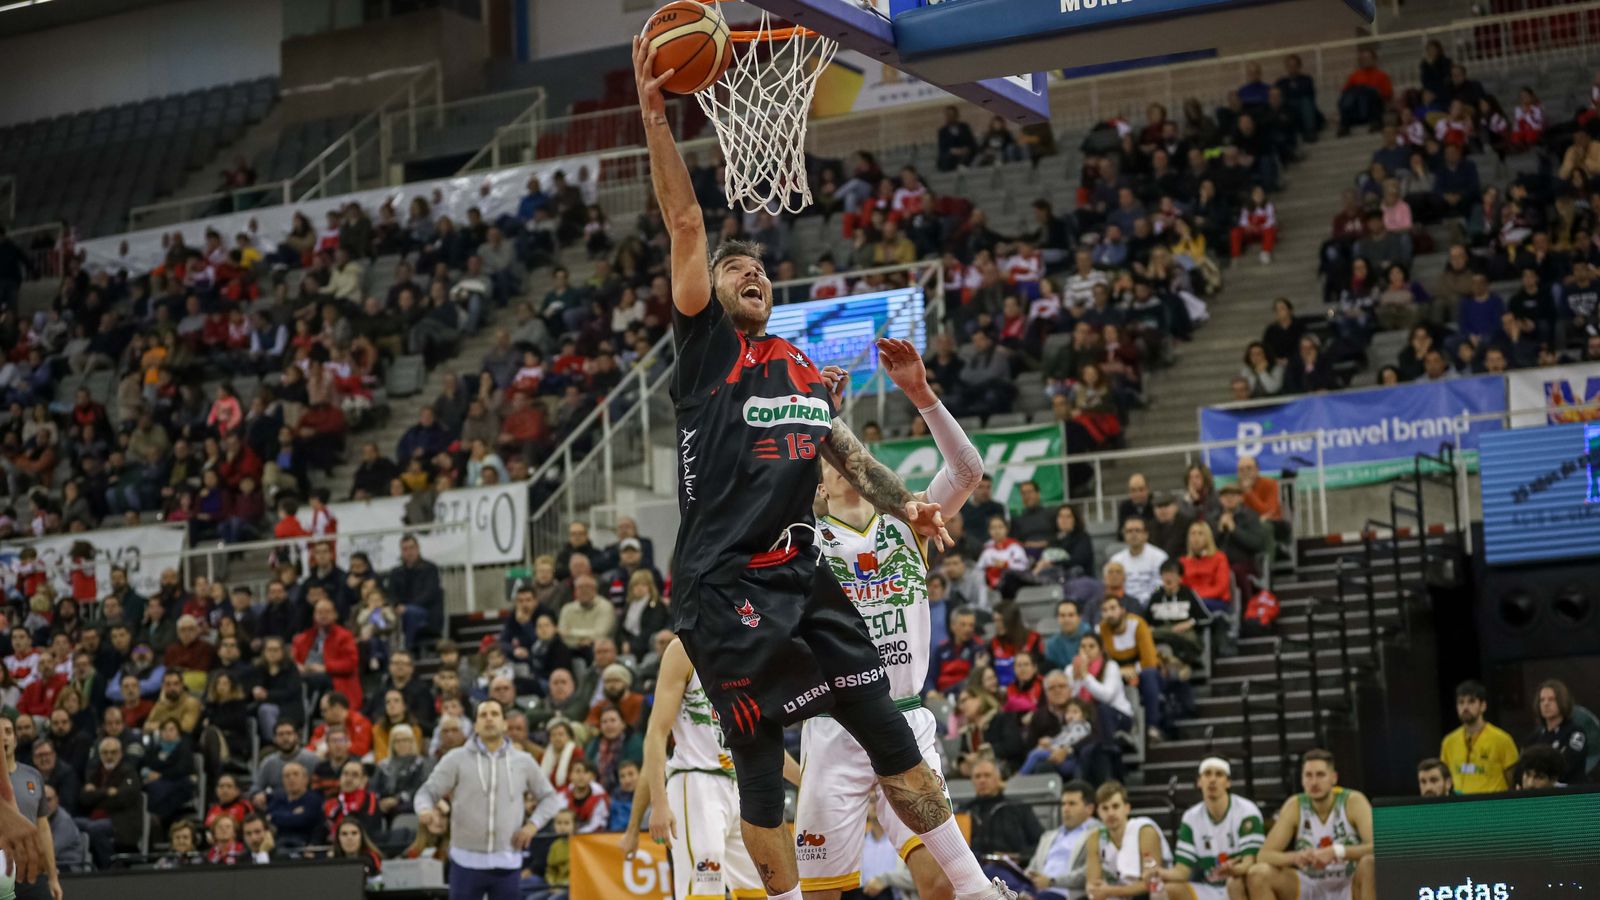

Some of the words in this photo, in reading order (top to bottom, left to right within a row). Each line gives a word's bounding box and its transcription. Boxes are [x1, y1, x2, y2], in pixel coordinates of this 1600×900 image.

[1317, 418, 1389, 449] travel
[1392, 408, 1470, 442] brand
[785, 432, 816, 460] 15
[878, 640, 908, 657] ERNO
[880, 652, 913, 668] RAGON
[1418, 876, 1510, 900] aedas
